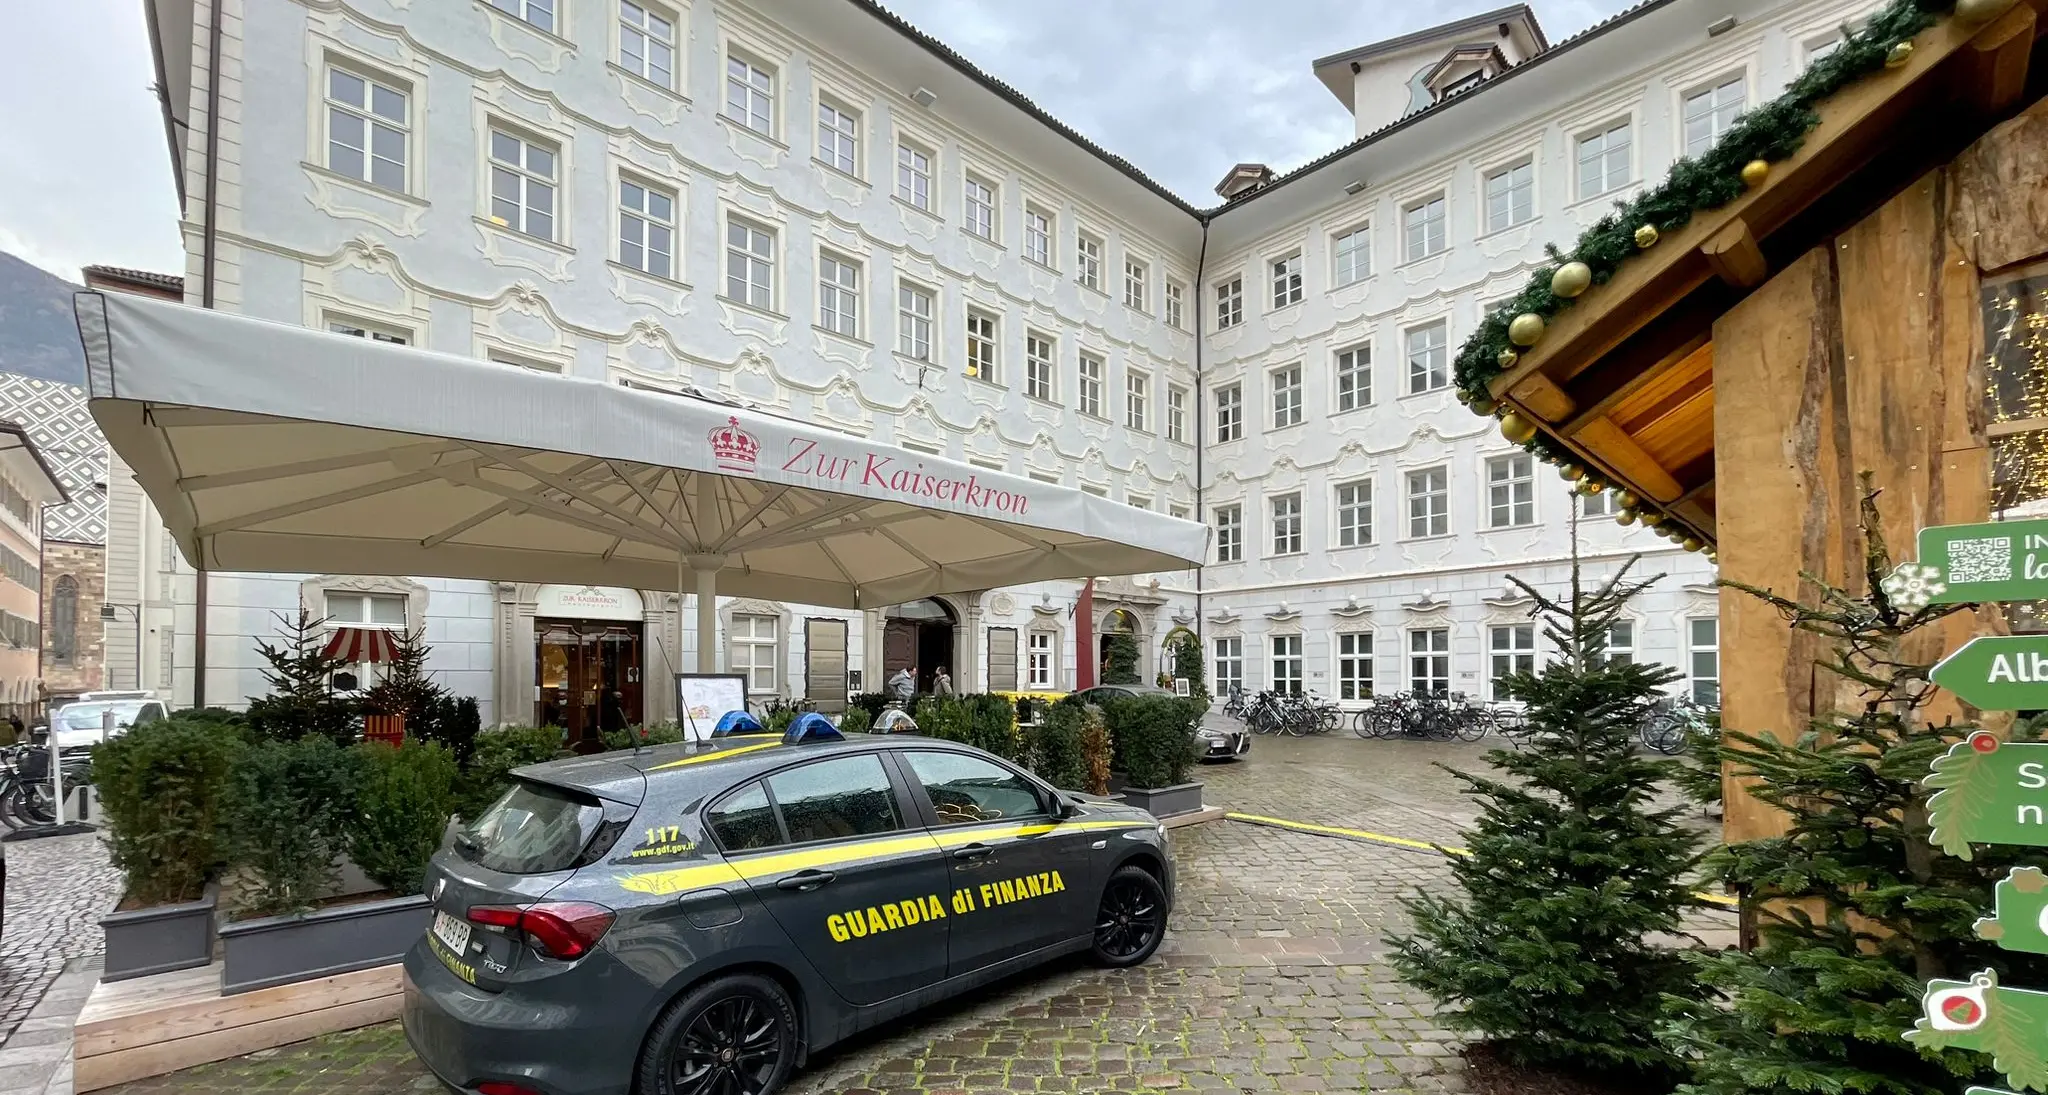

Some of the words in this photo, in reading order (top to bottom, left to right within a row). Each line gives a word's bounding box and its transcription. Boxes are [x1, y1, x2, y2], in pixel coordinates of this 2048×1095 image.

[781, 437, 858, 481] Zur
[859, 453, 1028, 515] Kaiserkron
[631, 842, 696, 858] www.gdf.gov.it
[645, 825, 679, 846] 117
[827, 894, 946, 943] GUARDIA
[952, 888, 975, 914] di
[979, 870, 1065, 908] FINANZA
